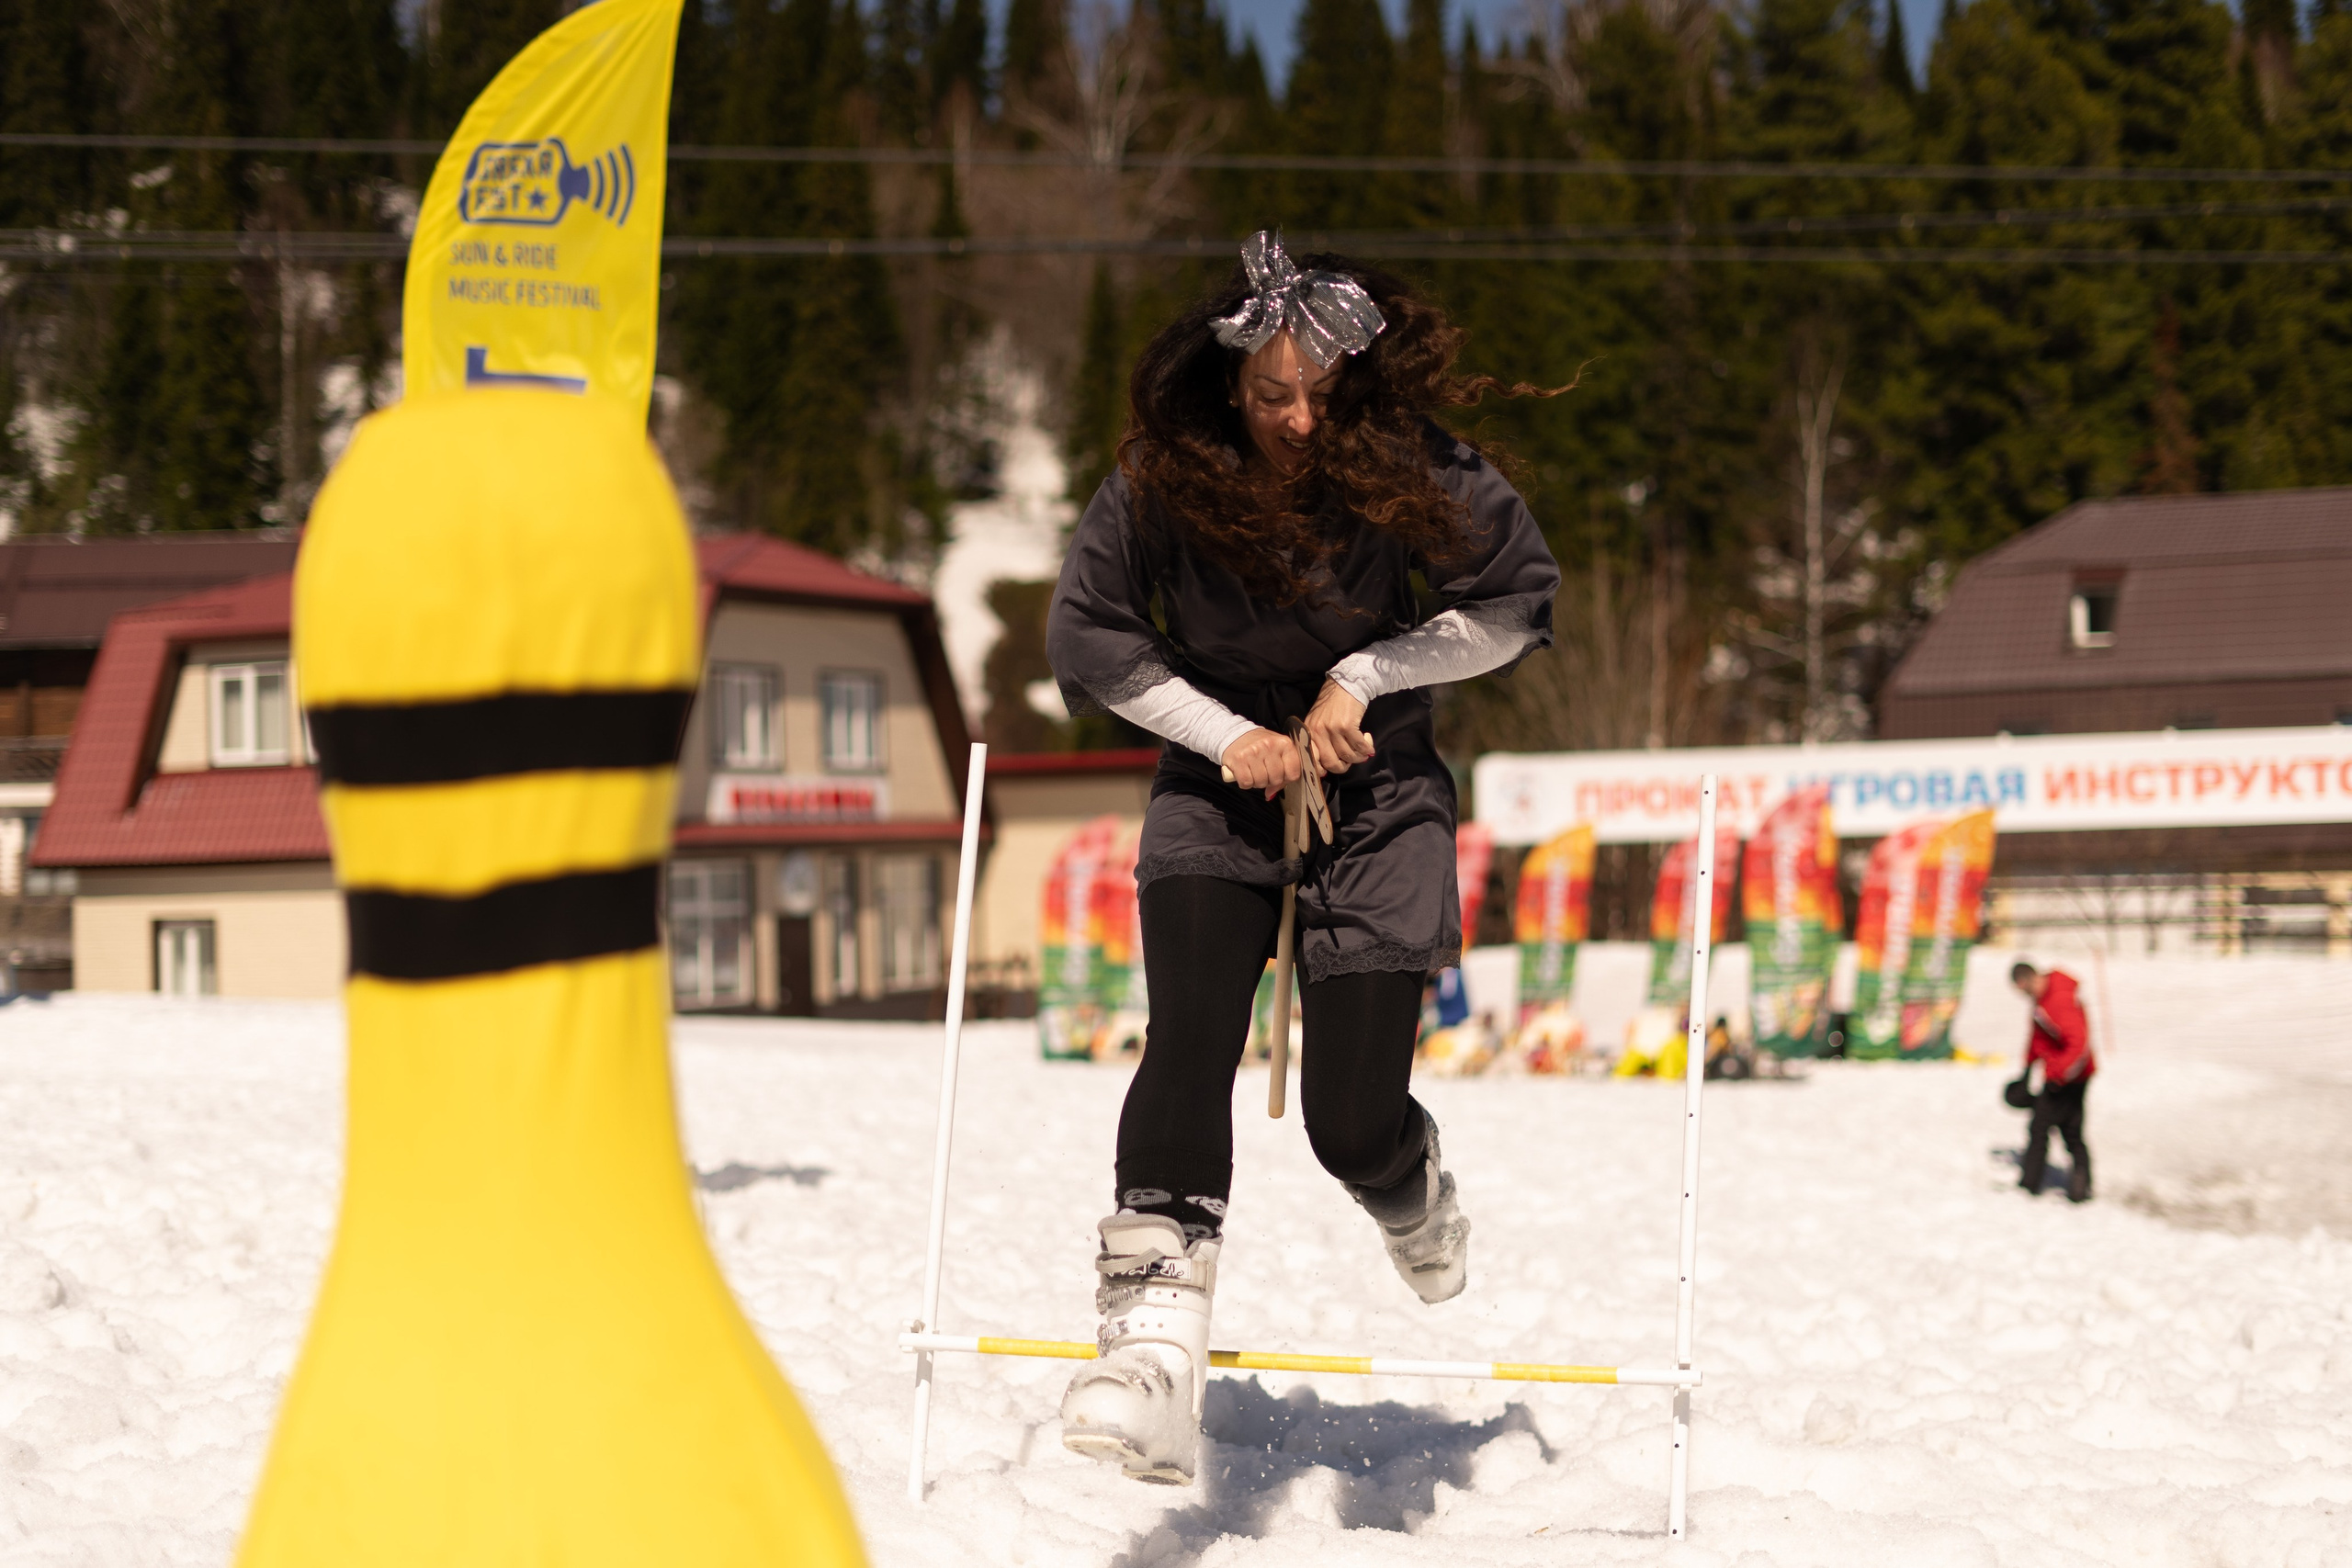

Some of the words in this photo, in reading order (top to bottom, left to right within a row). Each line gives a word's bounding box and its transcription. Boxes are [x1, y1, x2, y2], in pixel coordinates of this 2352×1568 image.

[449, 240, 489, 265] SUN
[494, 243, 508, 267] &
[513, 243, 559, 270] RIDE
[448, 277, 511, 305] MUSIC
[515, 279, 601, 310] FESTIVAL
[1575, 776, 1766, 818] ПРОКАТ
